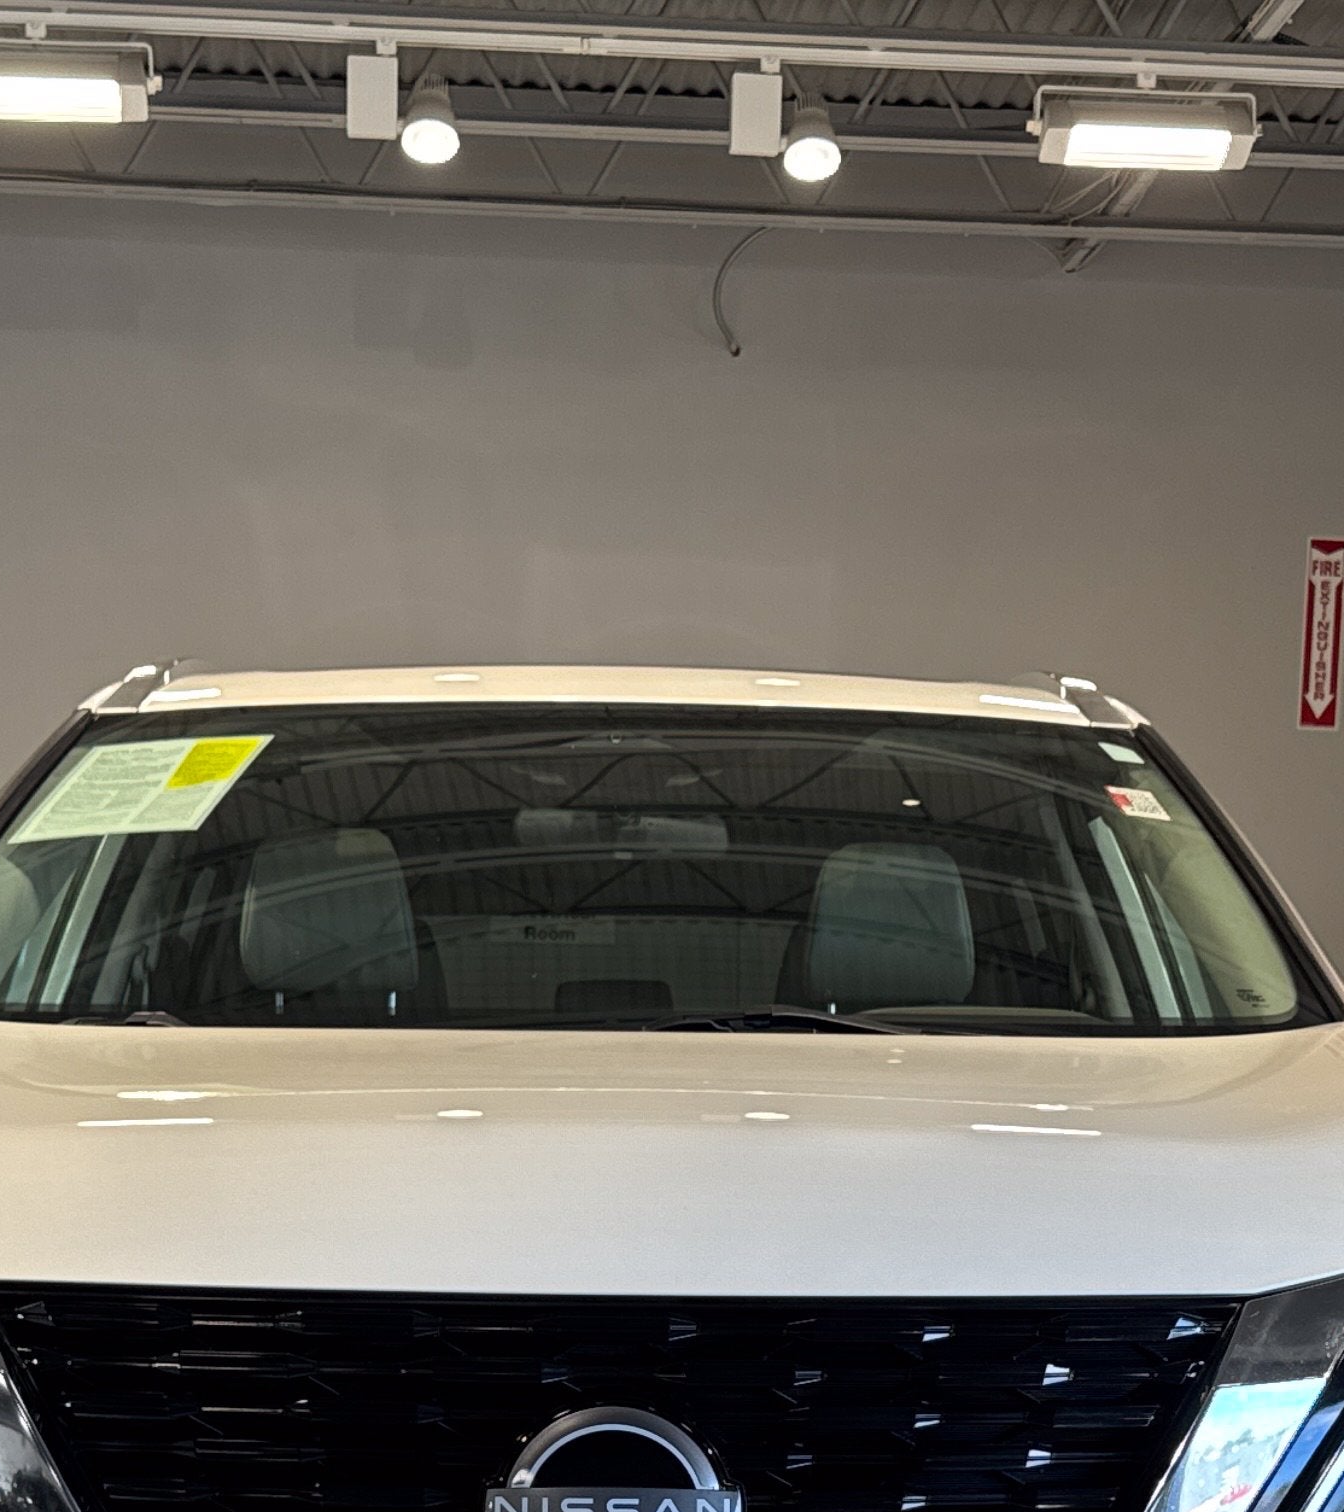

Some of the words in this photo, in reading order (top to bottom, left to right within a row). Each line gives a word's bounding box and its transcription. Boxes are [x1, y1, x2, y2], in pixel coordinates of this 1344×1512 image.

[1312, 560, 1342, 577] FIRE
[1313, 581, 1331, 701] EXTINGUISHER
[523, 926, 576, 941] Room
